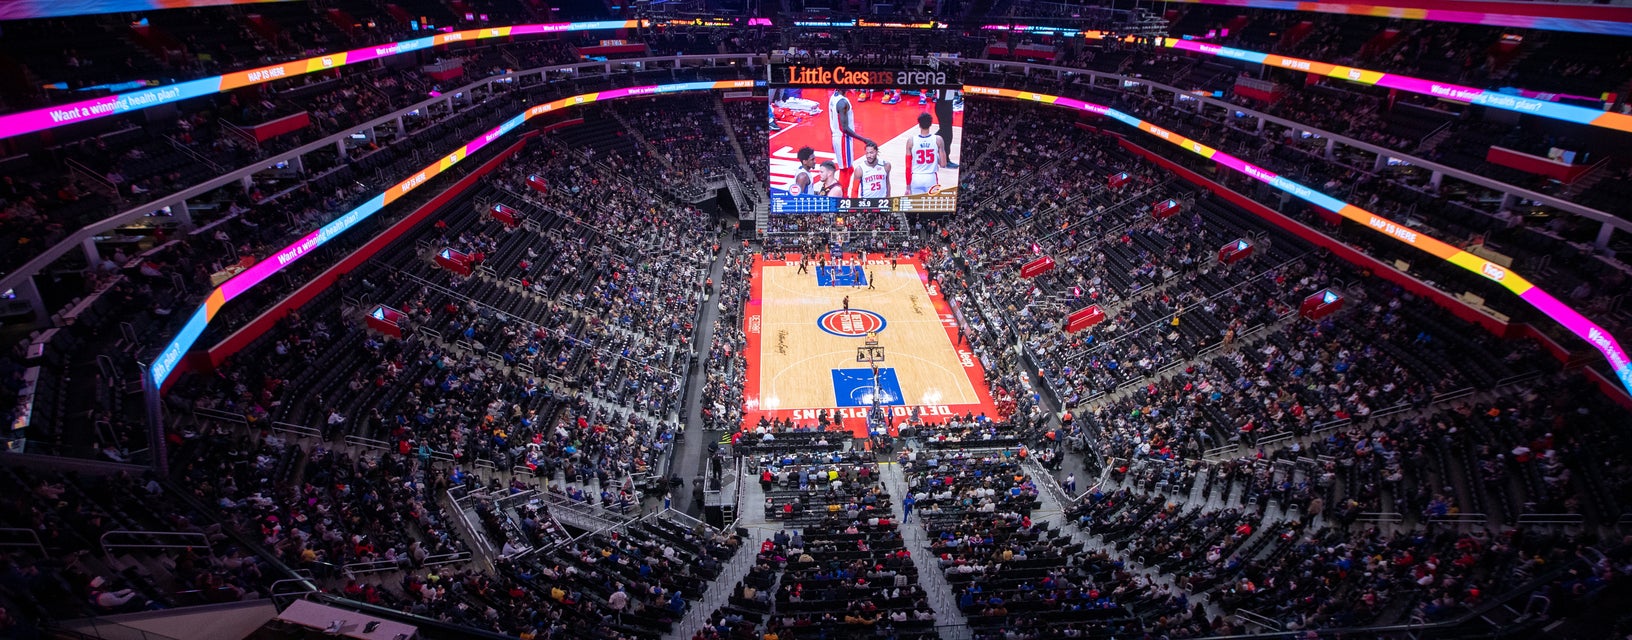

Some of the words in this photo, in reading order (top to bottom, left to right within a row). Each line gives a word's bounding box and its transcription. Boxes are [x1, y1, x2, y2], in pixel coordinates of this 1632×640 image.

[248, 71, 261, 82] HAP
[261, 70, 269, 79] IS
[269, 66, 286, 77] HERE
[788, 66, 831, 85] Little
[833, 66, 893, 85] Caesars
[897, 71, 945, 85] arena
[50, 107, 82, 122] Want
[82, 107, 90, 117] a
[90, 99, 129, 114] winning
[128, 92, 157, 105] health
[158, 87, 180, 102] plan?
[1431, 84, 1451, 96] Want
[1457, 90, 1487, 103] winning
[1488, 94, 1515, 106] health
[1514, 100, 1542, 111] plan?
[916, 149, 935, 164] 35
[871, 182, 881, 191] 25
[840, 200, 851, 208] 29
[878, 199, 889, 208] 22
[278, 247, 297, 265] Want
[297, 246, 303, 254] a
[302, 233, 326, 251] winning
[325, 220, 344, 237] health
[344, 211, 358, 227] plan?
[1370, 217, 1386, 229] HAP
[1385, 223, 1395, 234] IS
[1395, 227, 1417, 243] HERE
[1484, 263, 1504, 280] hap
[1588, 327, 1611, 351] Want
[164, 342, 180, 372] plan?
[959, 349, 975, 367] Jeep
